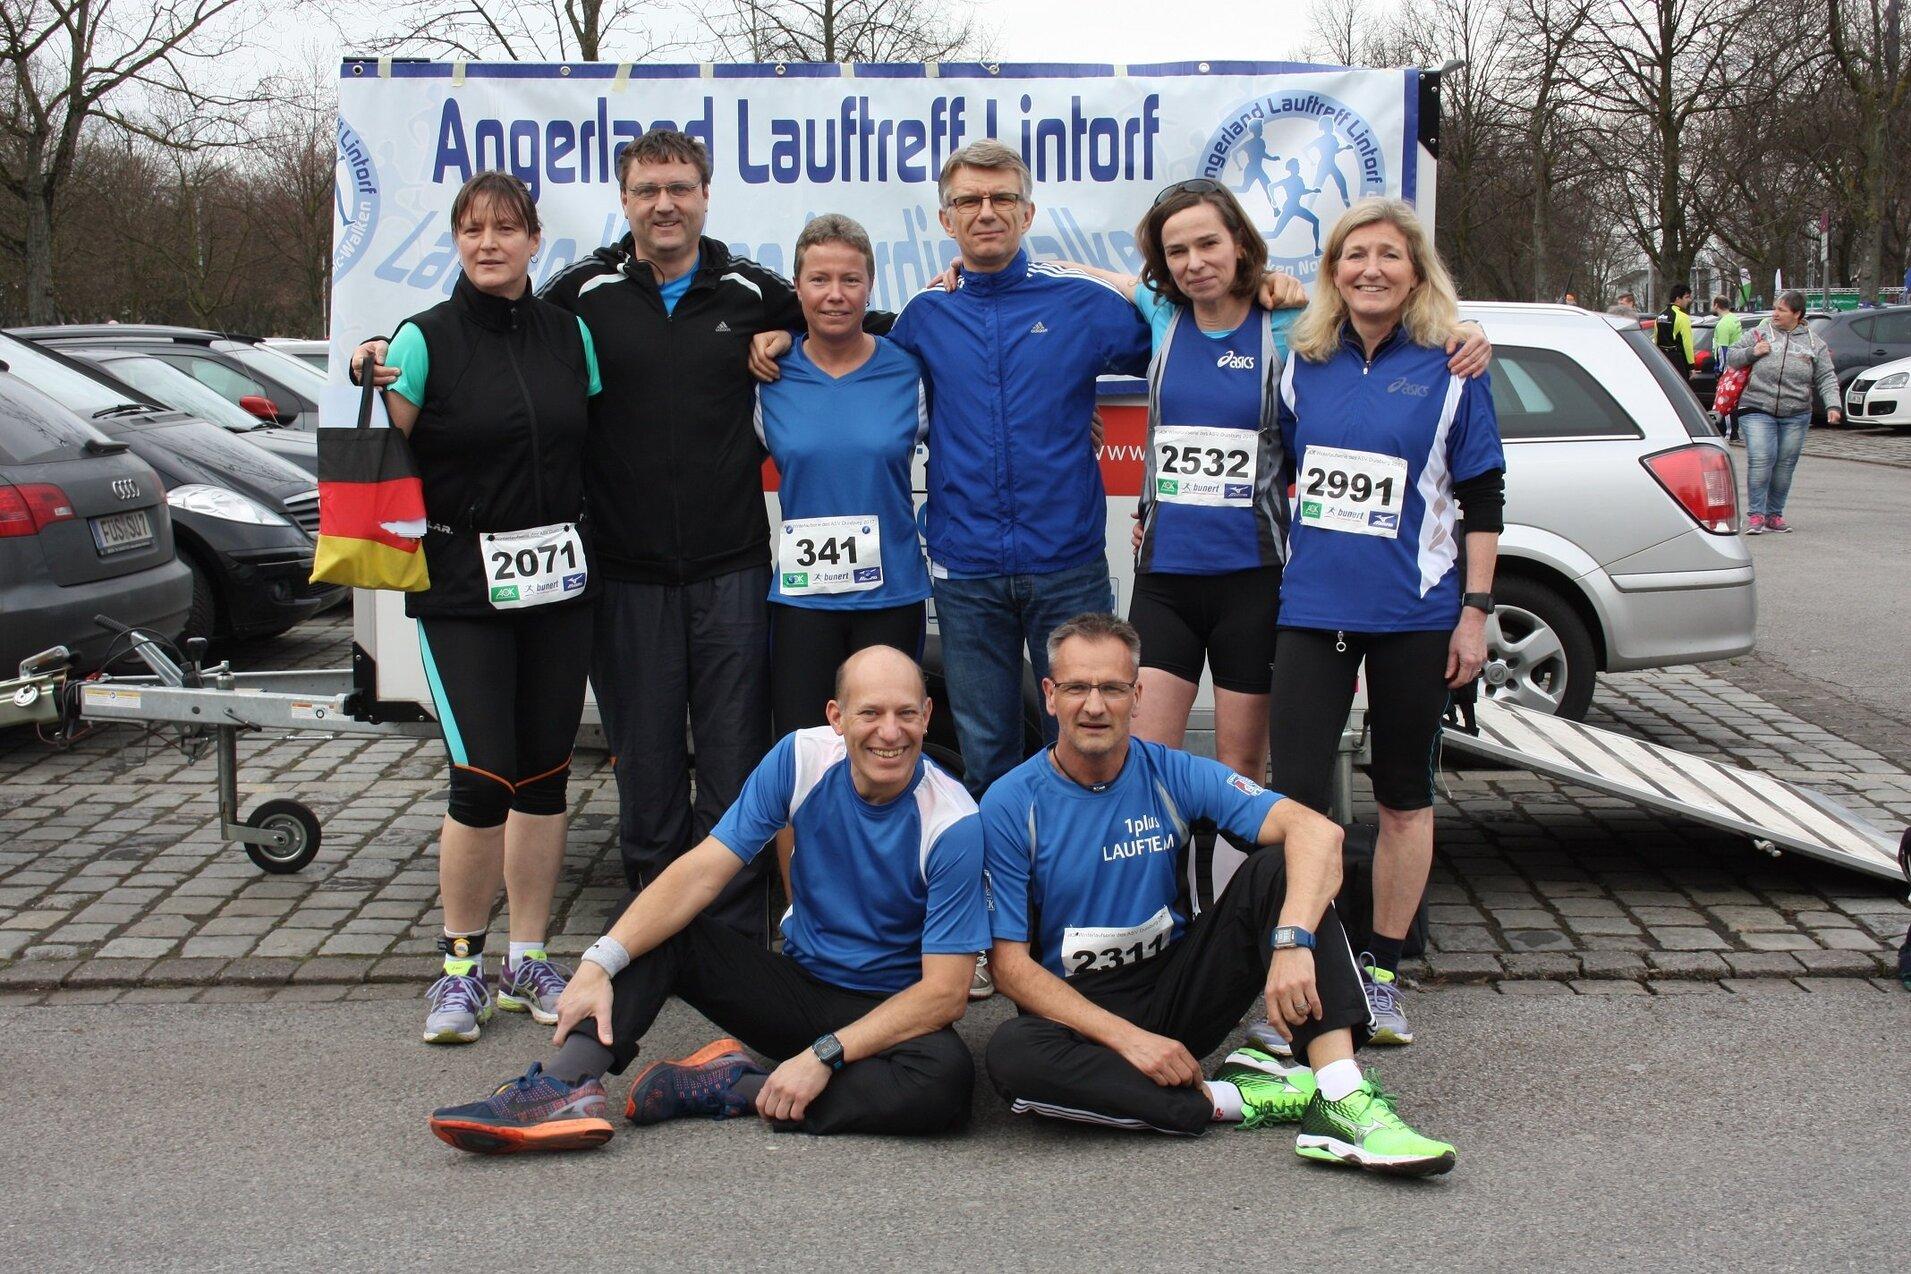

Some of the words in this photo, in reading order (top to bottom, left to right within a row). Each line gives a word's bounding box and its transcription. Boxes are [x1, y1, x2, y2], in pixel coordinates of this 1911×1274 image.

[432, 96, 714, 204] Angerlad
[737, 95, 966, 184] Lauftreff
[1203, 102, 1265, 179] ngerland
[1267, 95, 1352, 126] Lauftreff
[1346, 119, 1383, 184] Lintorf
[340, 129, 377, 195] Lintorf
[1161, 445, 1250, 478] 2532
[1193, 482, 1220, 493] bunert
[1306, 467, 1393, 506] 2991
[1337, 508, 1365, 519] bunert
[491, 540, 576, 580] 2071
[796, 536, 858, 567] 341
[536, 579, 559, 591] bunert
[824, 572, 849, 581] bunert
[1124, 814, 1160, 837] 1plus
[1103, 833, 1174, 861] LAUFTEM
[1072, 932, 1164, 976] 2311
